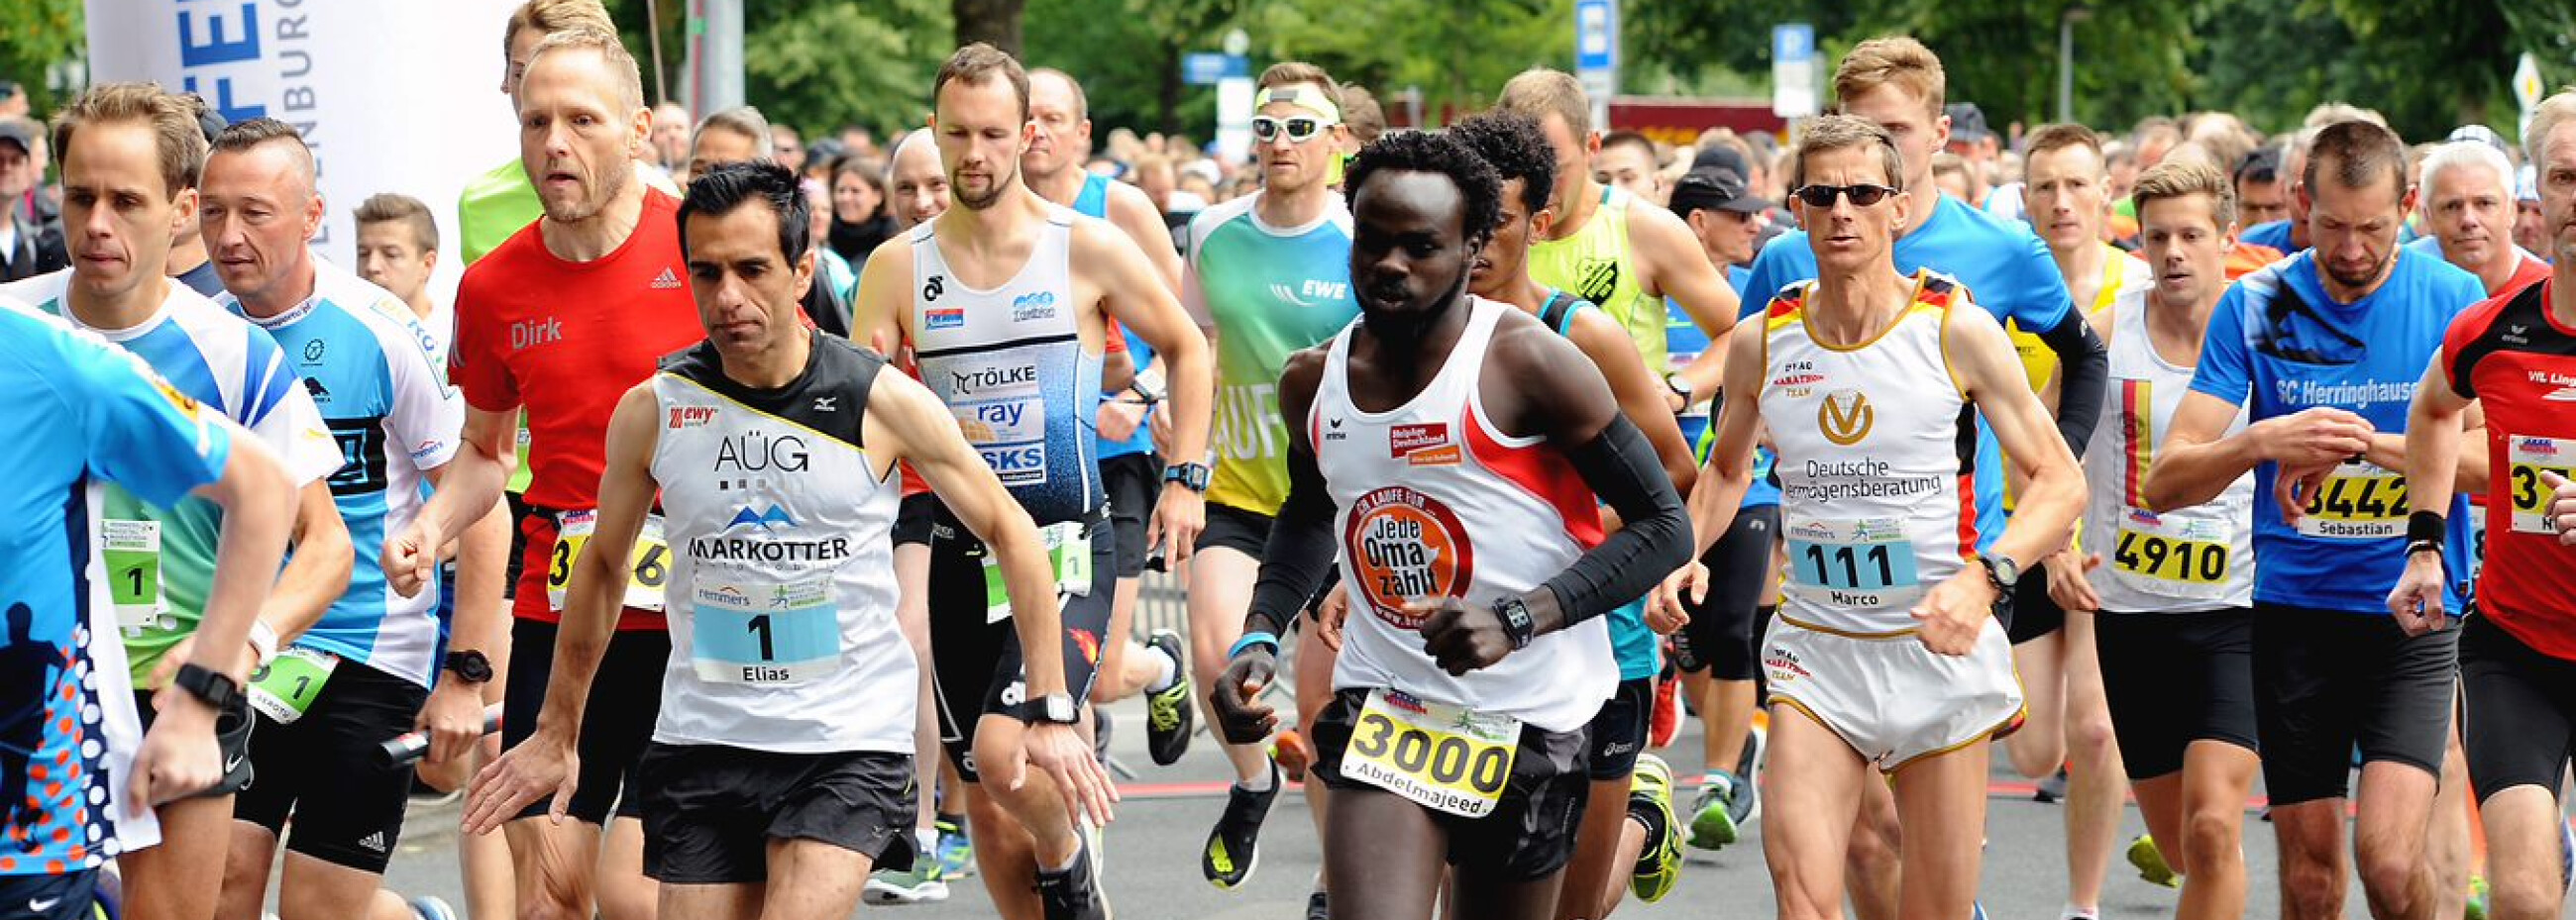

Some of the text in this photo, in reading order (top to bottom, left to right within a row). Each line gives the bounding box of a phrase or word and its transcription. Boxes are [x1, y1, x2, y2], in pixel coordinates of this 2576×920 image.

[1302, 279, 1347, 300] EWE
[511, 316, 562, 350] Dirk
[972, 365, 1036, 387] TÖLKE
[2277, 380, 2298, 404] SC
[684, 406, 714, 425] ewy
[977, 402, 1024, 427] ray
[713, 430, 808, 472] AÜG
[1806, 457, 1889, 479] Deutsche
[1786, 475, 1942, 503] ermögensberatung
[1375, 518, 1420, 540] Jede
[2318, 521, 2394, 536] Sebastian
[1365, 537, 1427, 568] Oma
[2114, 532, 2226, 581] 4910
[1805, 543, 1893, 588] 111
[128, 567, 143, 596] 1
[1378, 567, 1439, 596] zählt
[698, 588, 751, 607] remmers
[1830, 590, 1879, 606] Marco
[748, 613, 775, 663] 1
[743, 665, 790, 682] Elias
[292, 675, 311, 700] 1
[1353, 713, 1510, 794] 3000
[1357, 762, 1484, 815] Abdelmajeed
